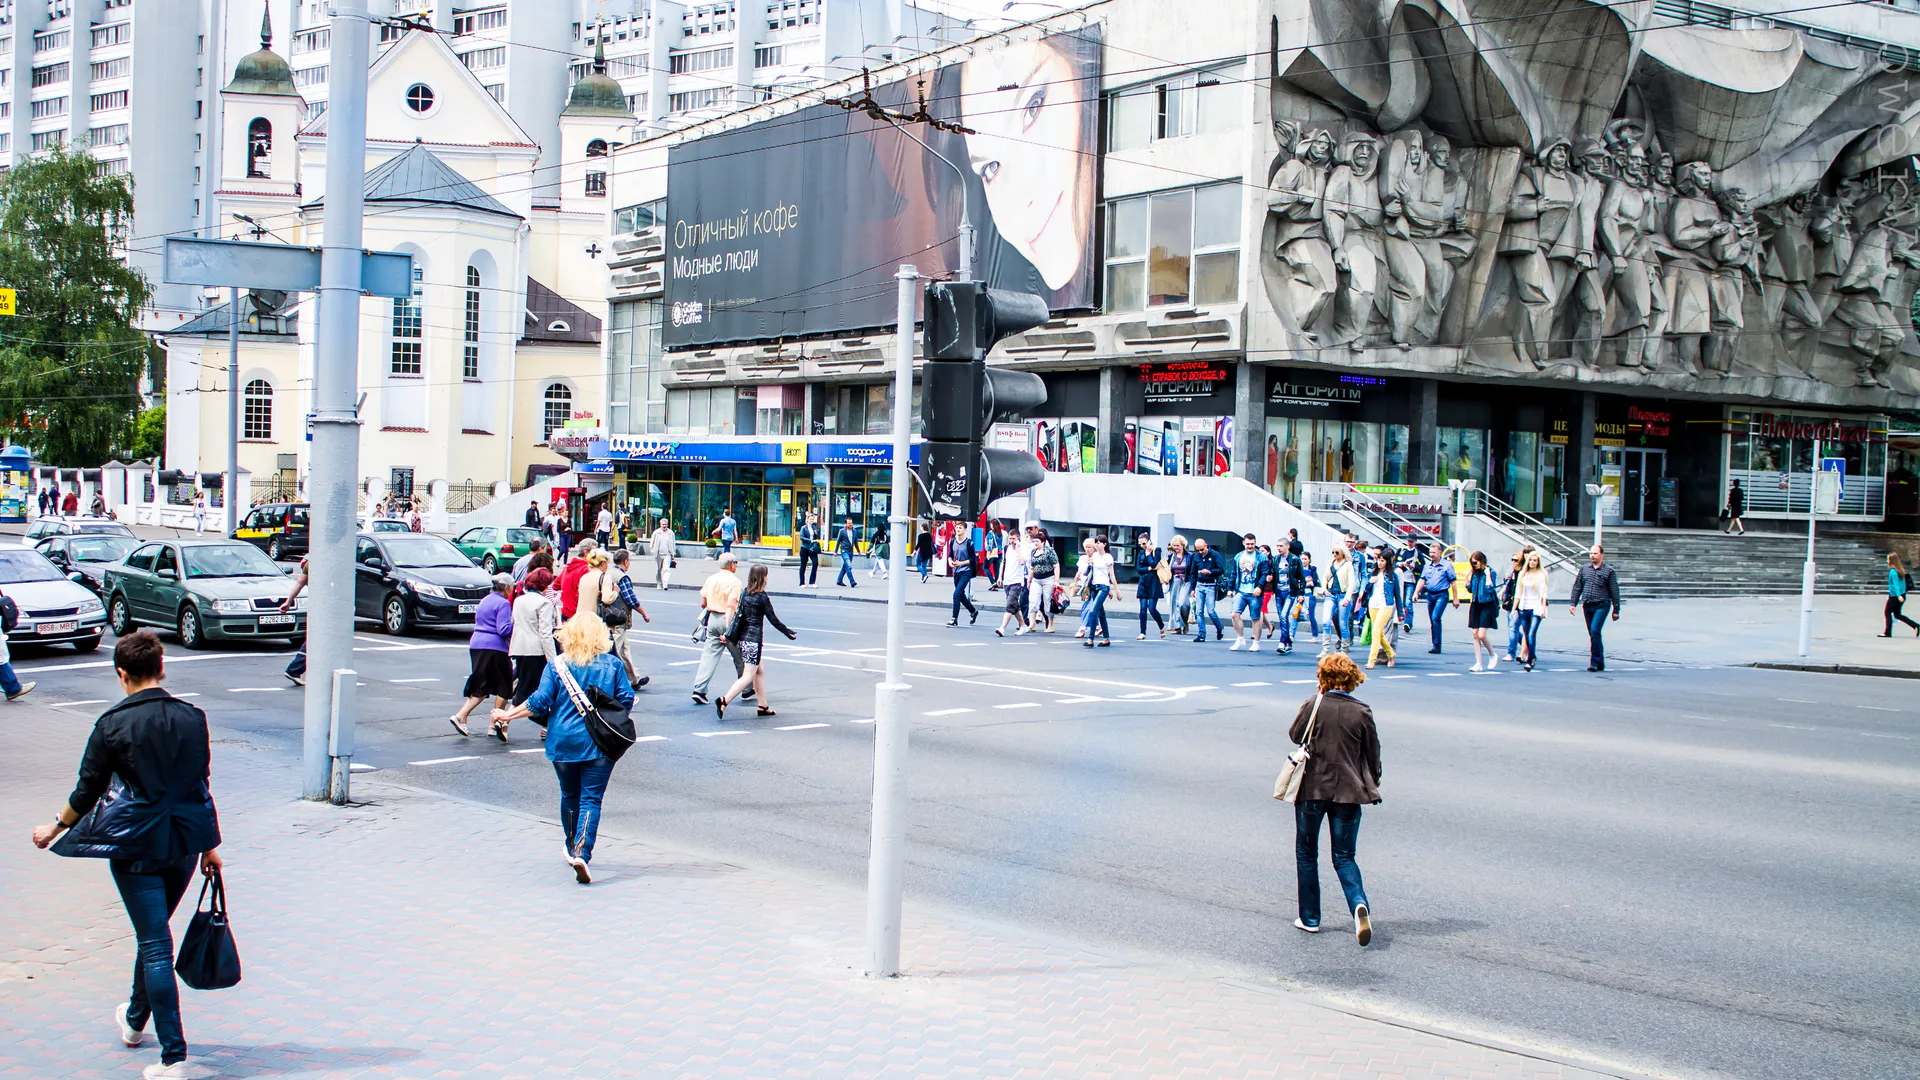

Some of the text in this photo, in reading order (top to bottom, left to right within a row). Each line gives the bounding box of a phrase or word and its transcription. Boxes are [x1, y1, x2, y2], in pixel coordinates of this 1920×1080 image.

[674, 200, 799, 249] Отличный кофе
[673, 249, 759, 280] Модные люди
[682, 302, 703, 313] Golden
[682, 313, 702, 325] Coffee
[1144, 381, 1212, 393] АЛГОРИТМ
[1273, 381, 1361, 399] АЛГОРИТМ
[1594, 423, 1626, 435] МОДЫ
[1761, 413, 1828, 440] Планета
[784, 446, 801, 457] velcom
